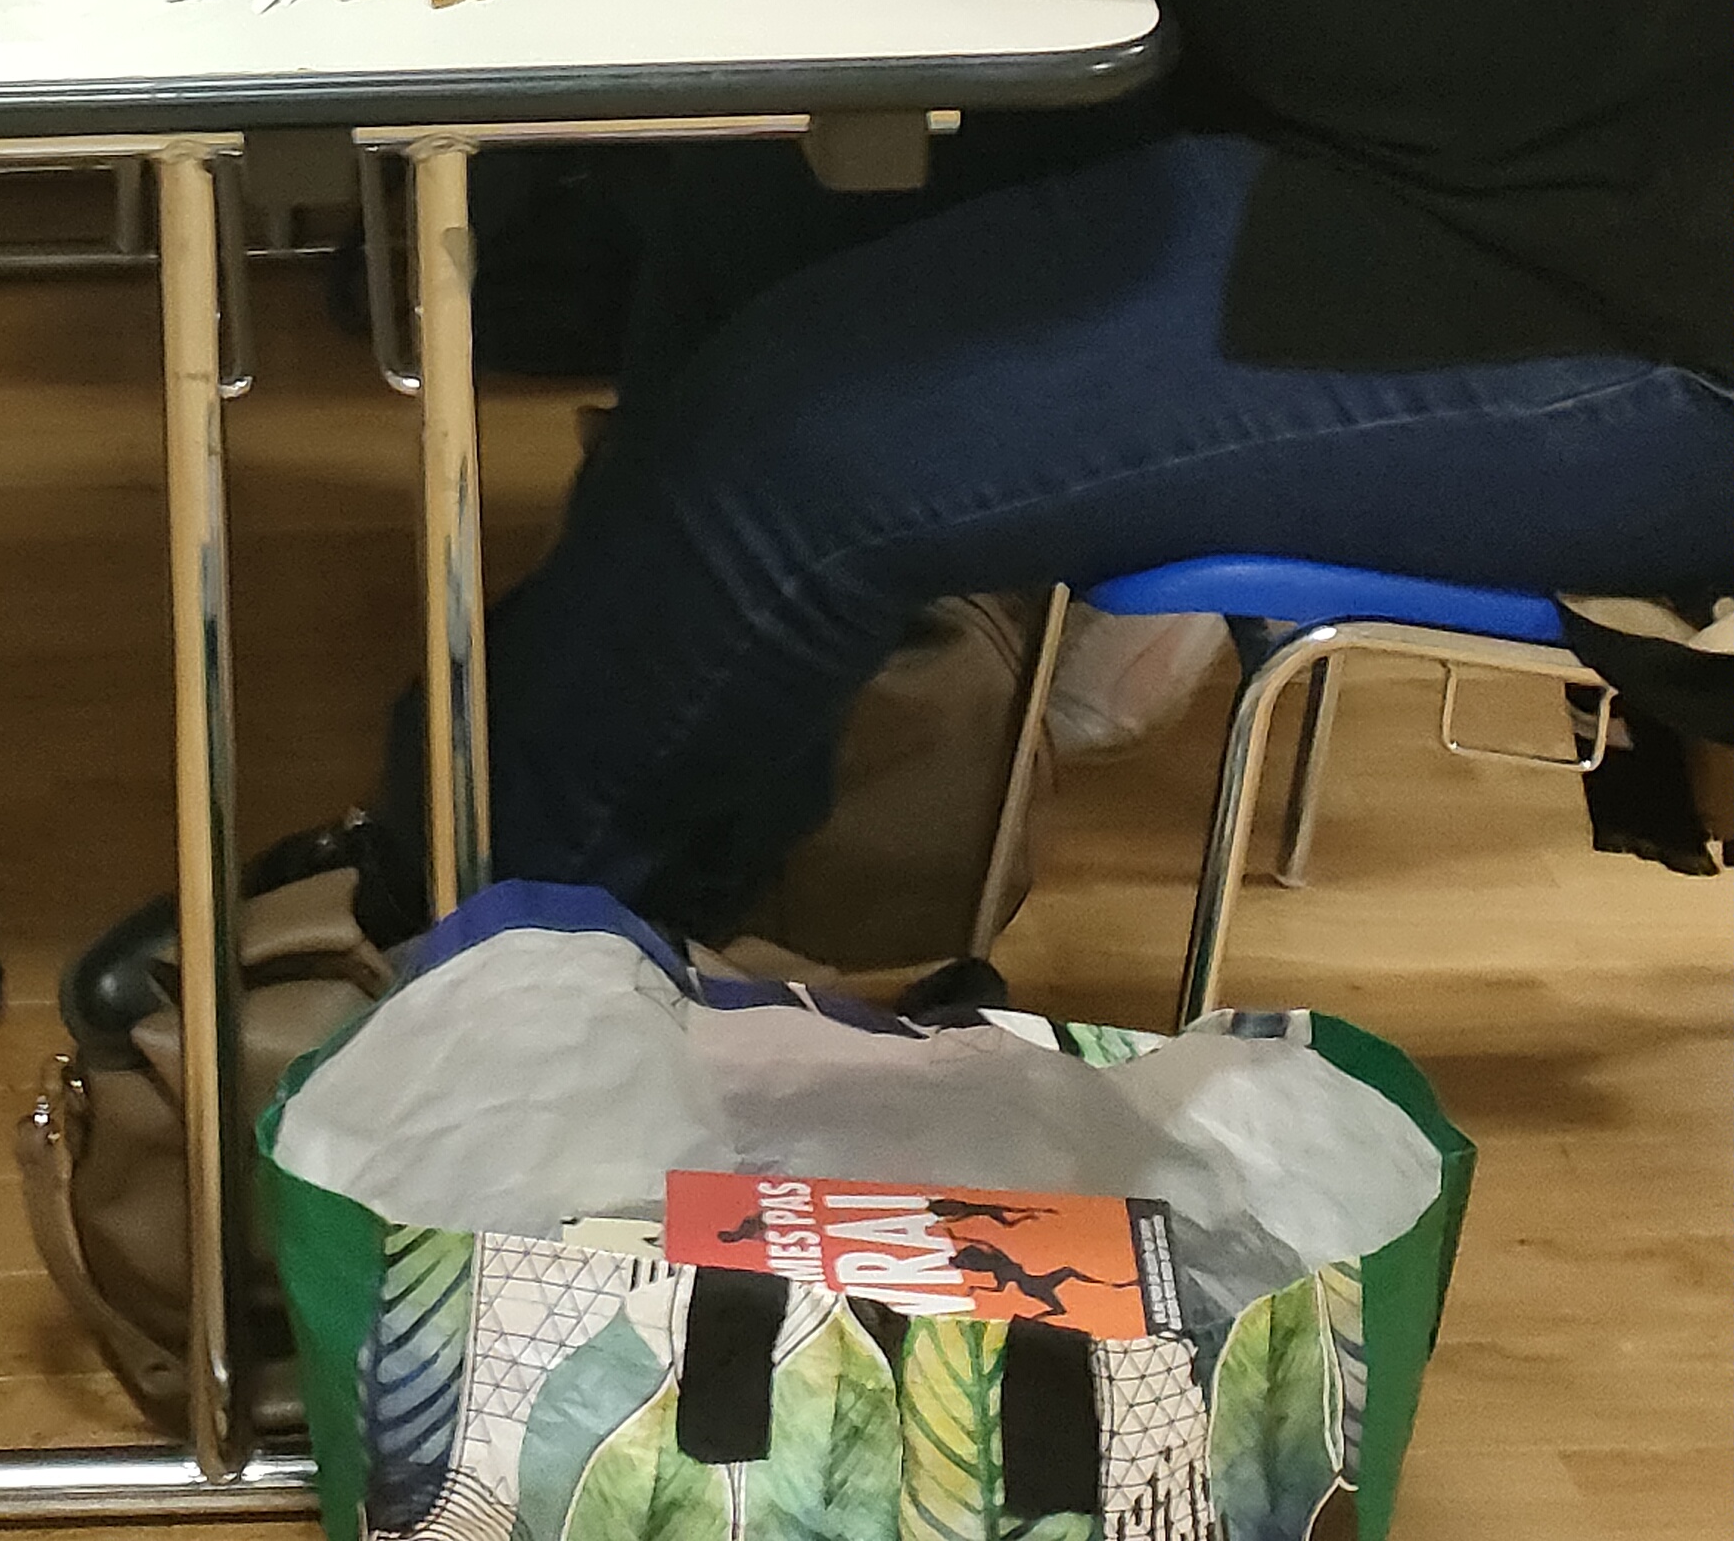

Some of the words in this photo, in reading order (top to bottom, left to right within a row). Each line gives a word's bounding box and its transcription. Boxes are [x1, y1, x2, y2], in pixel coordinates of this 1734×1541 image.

[757, 1182, 817, 1225] PAS
[764, 1230, 827, 1284] MES
[823, 1194, 977, 1316] VRAI
